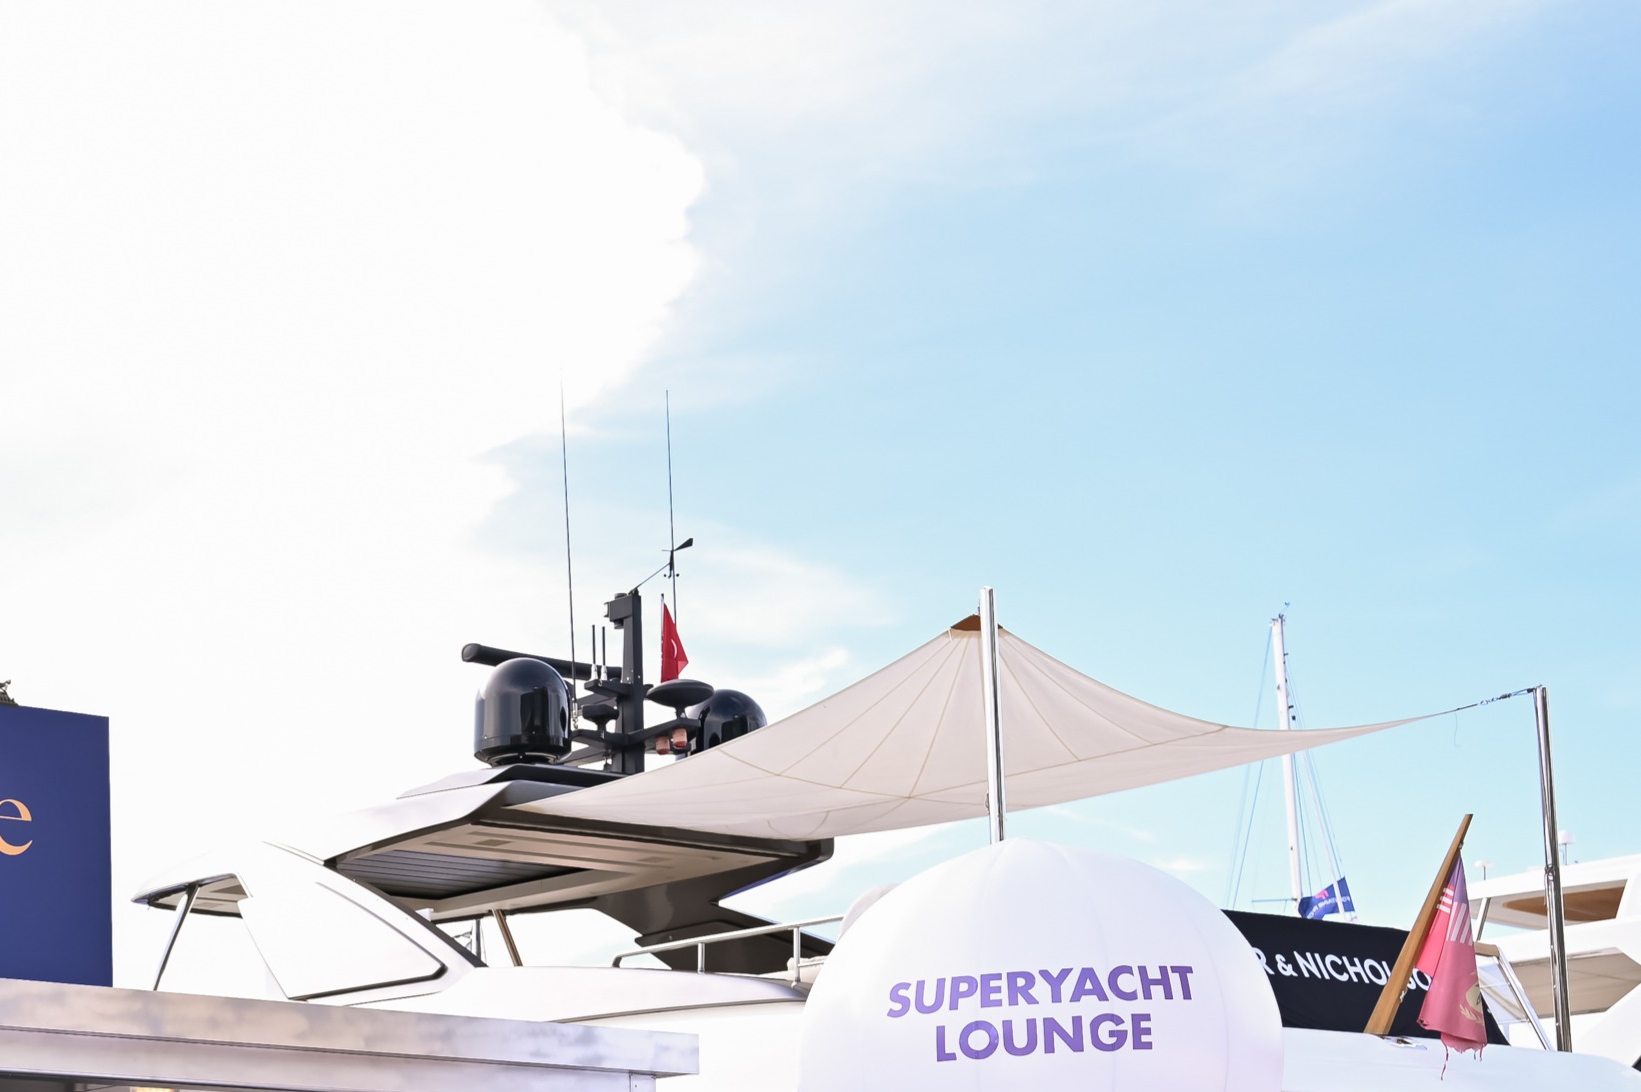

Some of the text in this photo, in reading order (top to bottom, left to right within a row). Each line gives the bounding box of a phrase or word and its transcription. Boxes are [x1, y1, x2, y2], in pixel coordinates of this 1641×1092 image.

[1275, 953, 1299, 977] &
[887, 965, 1193, 1018] SUPERYACHT
[936, 1013, 1153, 1062] LOUNGE
